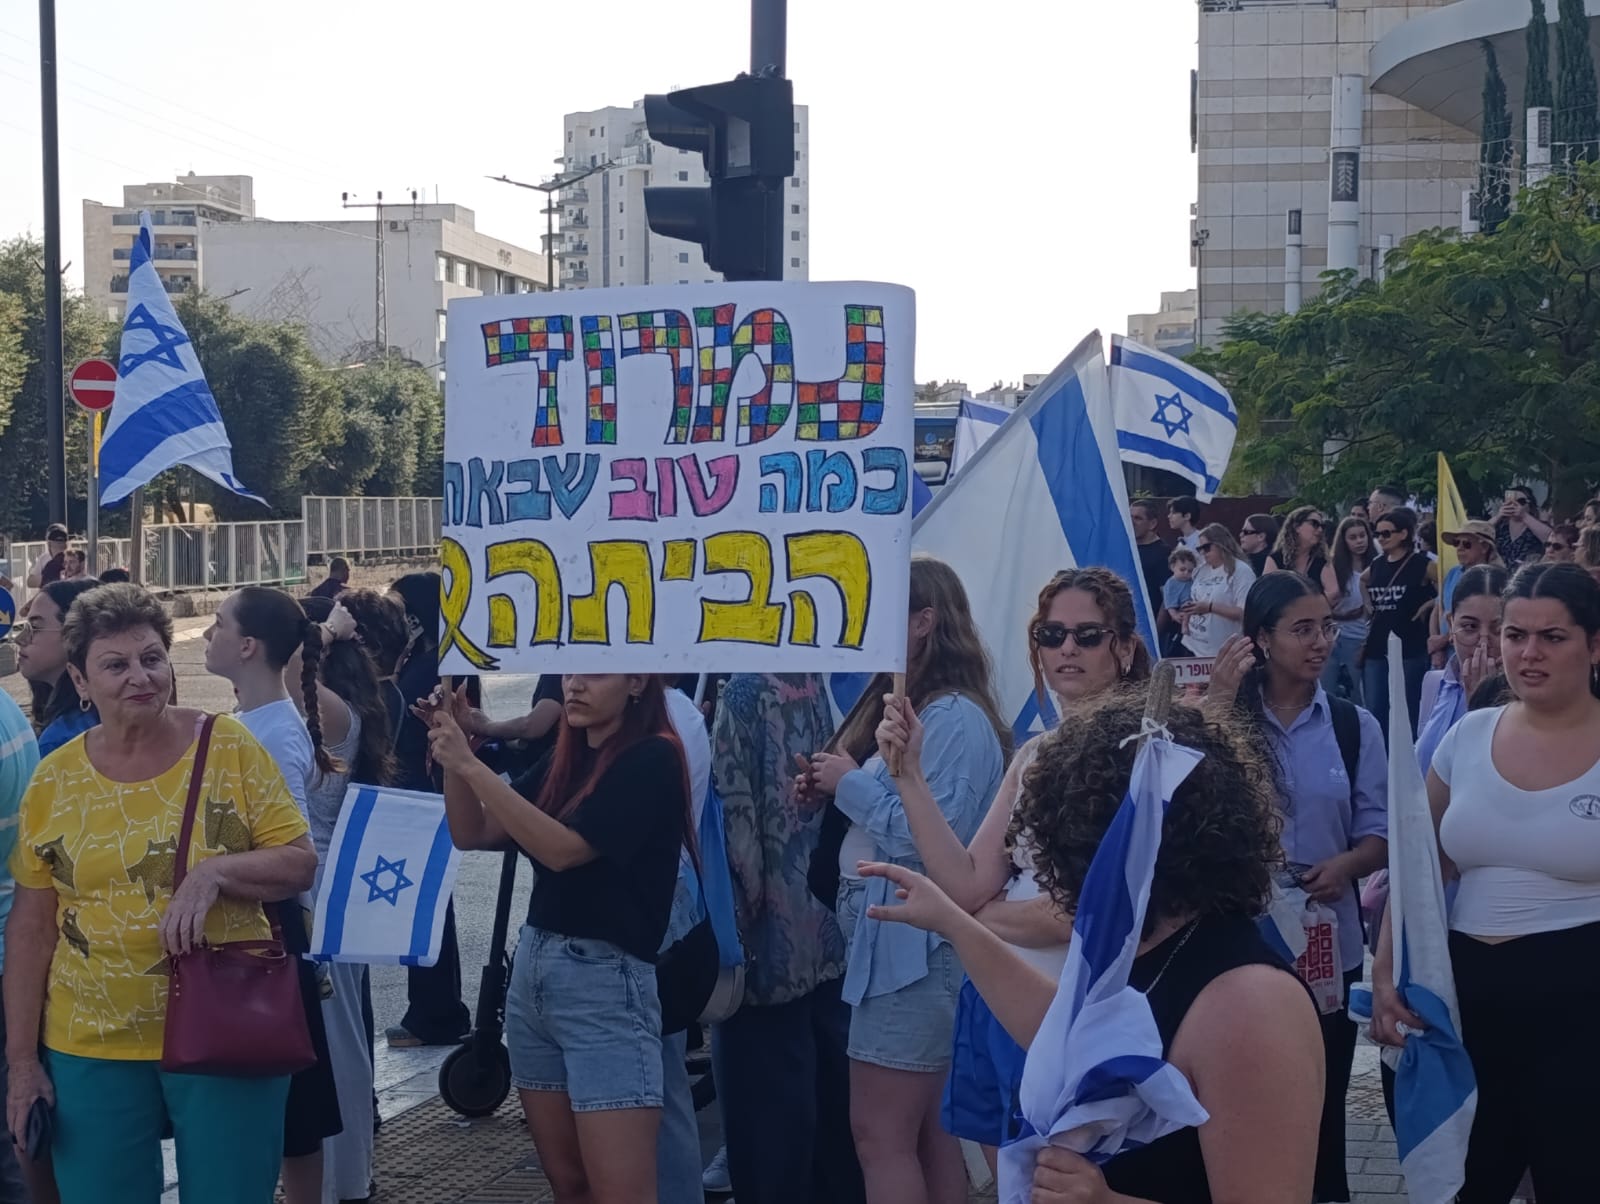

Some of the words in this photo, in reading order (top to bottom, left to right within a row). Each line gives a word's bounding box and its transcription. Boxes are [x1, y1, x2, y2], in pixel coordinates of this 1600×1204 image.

[481, 303, 885, 447] נמרוד
[608, 453, 740, 522] טוב
[758, 447, 909, 515] כמה
[485, 529, 873, 650] הביתה
